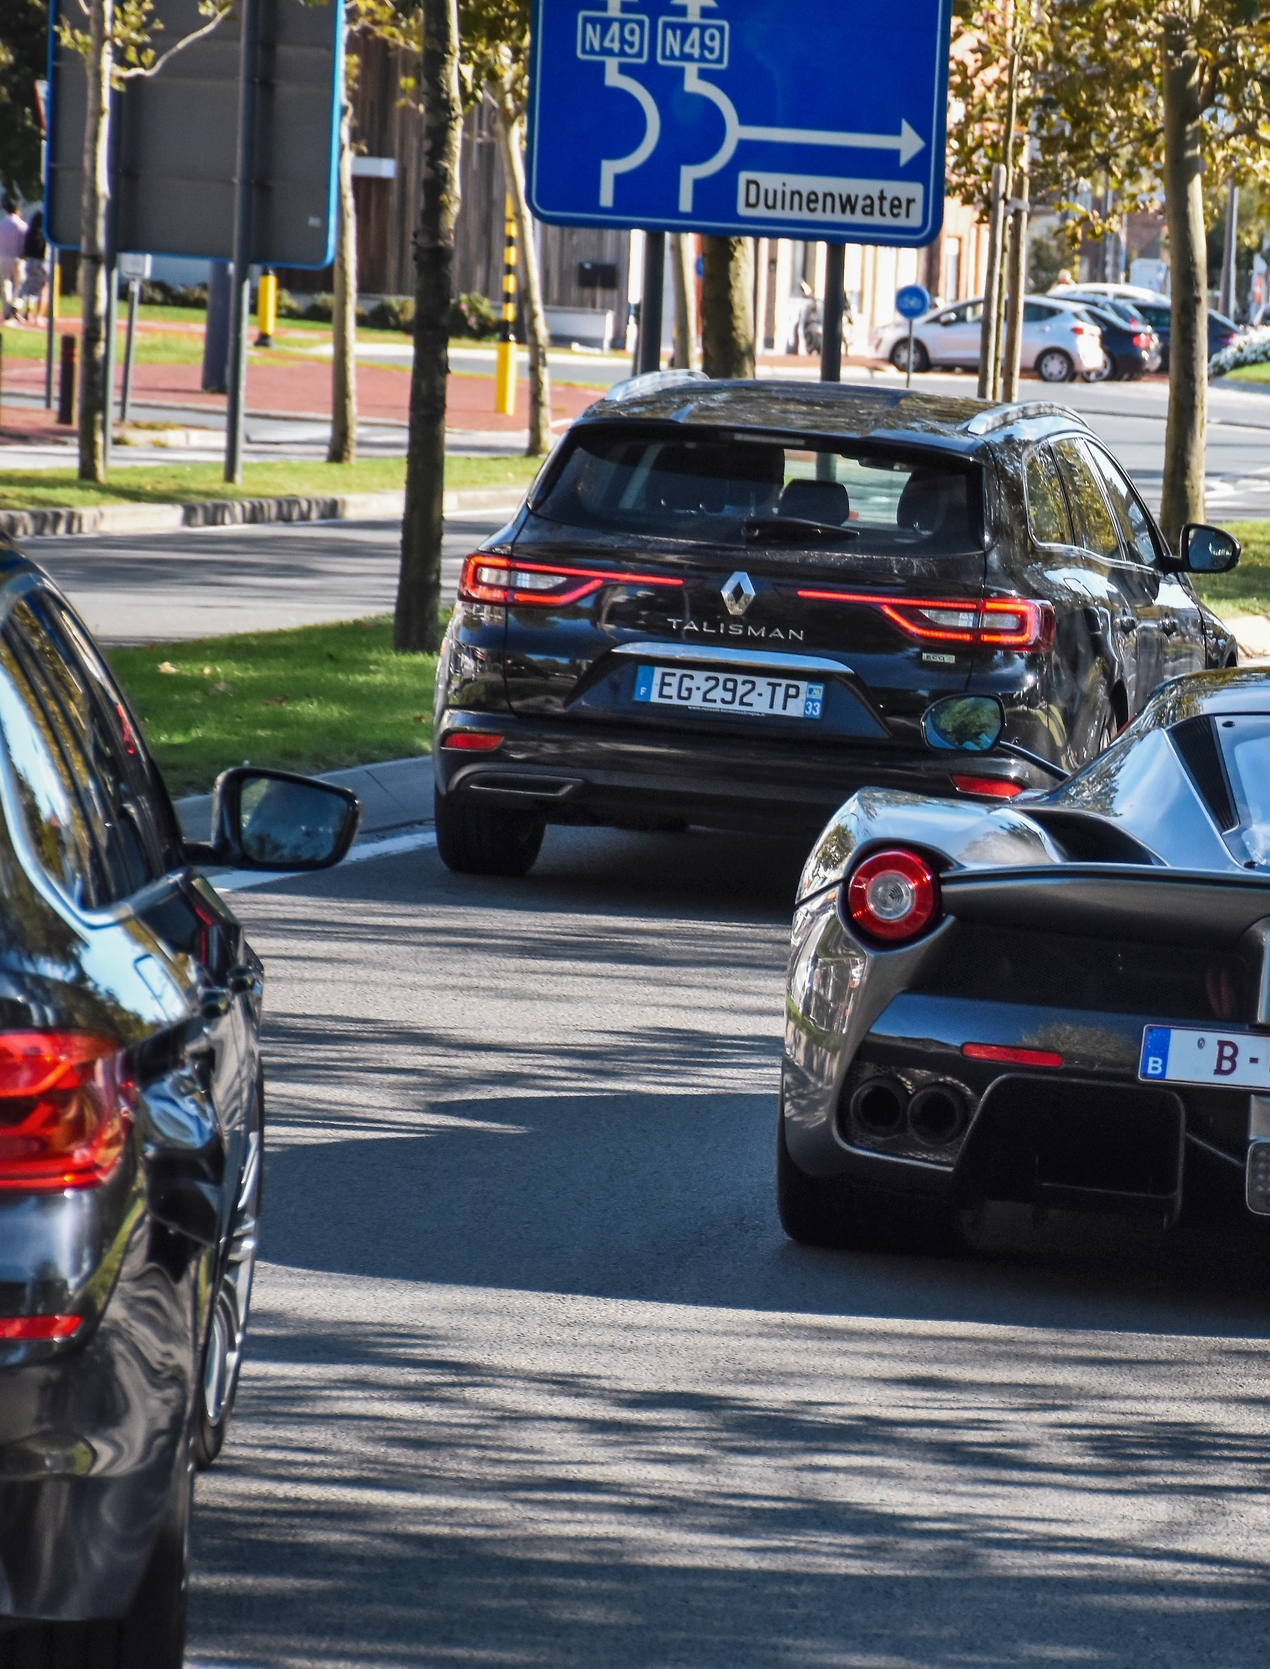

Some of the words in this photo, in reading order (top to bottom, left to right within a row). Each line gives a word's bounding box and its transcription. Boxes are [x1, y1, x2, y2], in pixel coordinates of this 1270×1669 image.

[585, 21, 640, 55] N49
[665, 27, 721, 60] N49
[744, 179, 916, 219] Duinenwater
[667, 618, 804, 641] TALISMAN
[640, 687, 647, 696] F
[657, 671, 801, 711] EG-292-TP
[804, 701, 821, 716] 33
[1147, 1057, 1162, 1075] B
